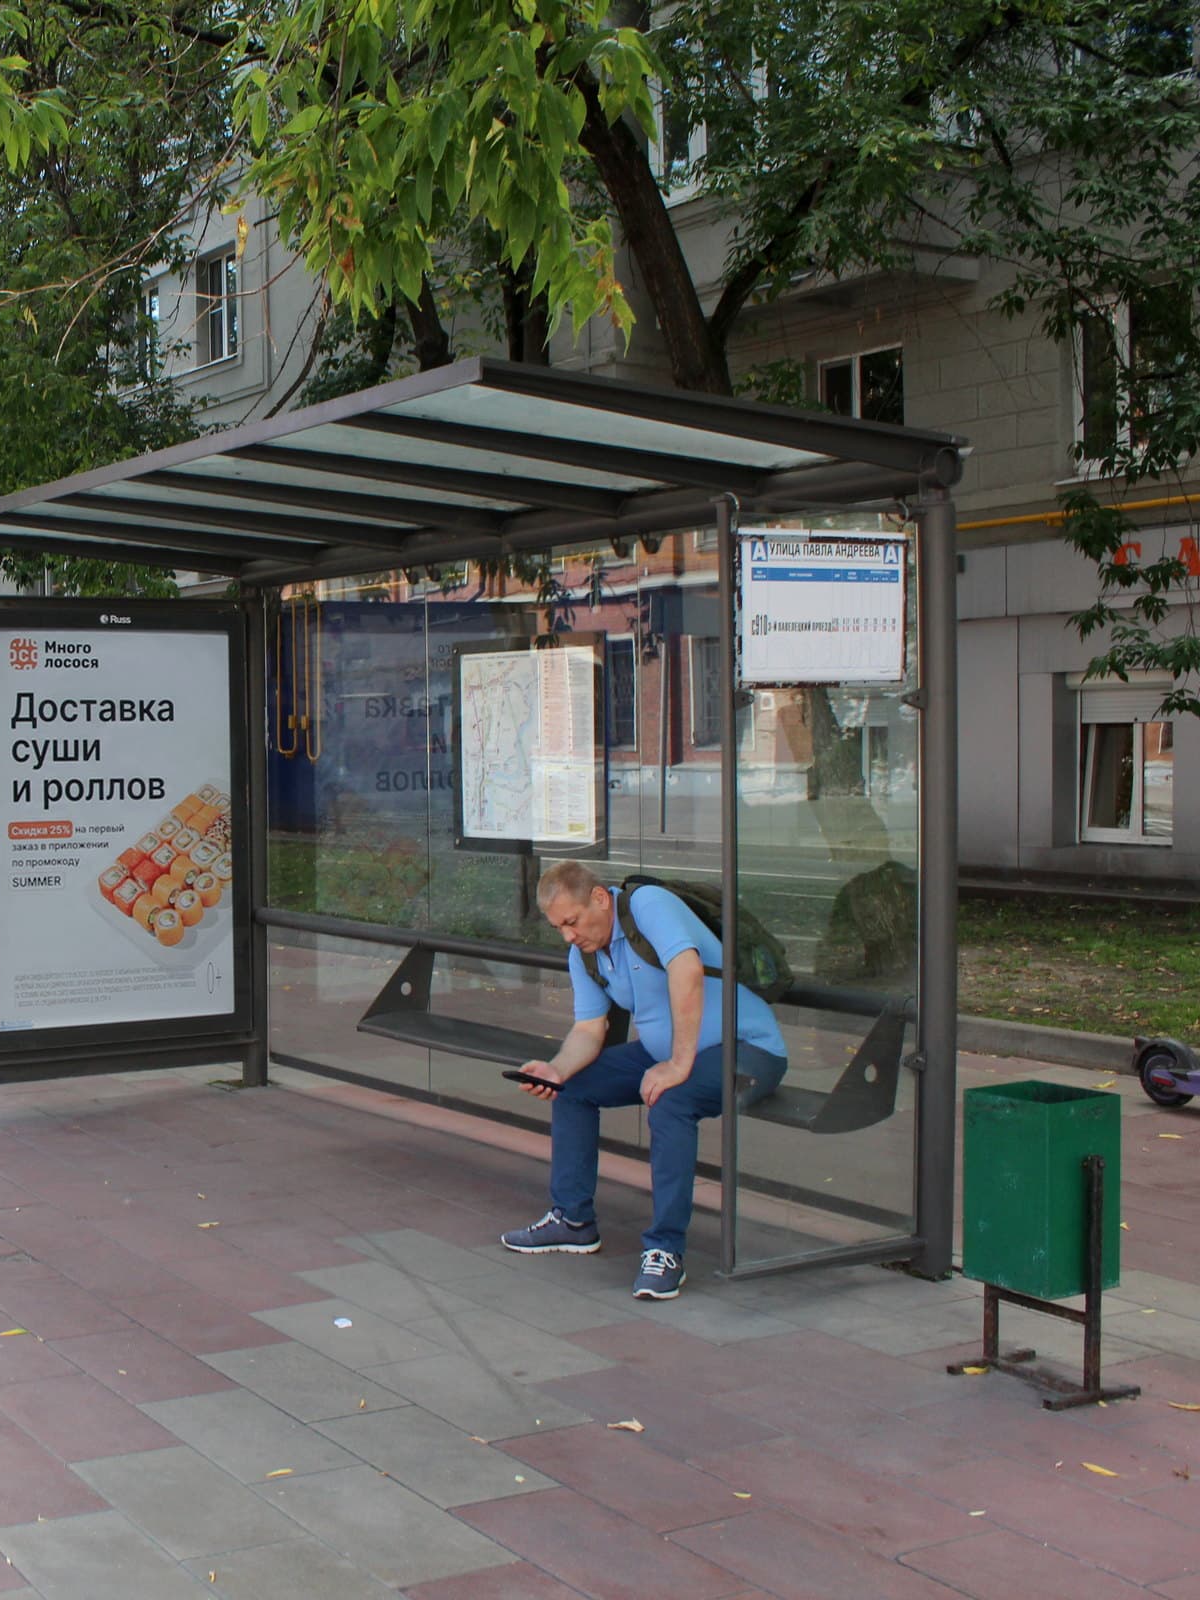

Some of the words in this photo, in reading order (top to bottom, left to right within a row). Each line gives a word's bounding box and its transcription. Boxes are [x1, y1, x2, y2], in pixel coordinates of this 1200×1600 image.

[769, 543, 800, 557] УЛИЦА
[803, 543, 833, 557] ПАВЛА
[835, 544, 880, 559] АНДРЕЕВА
[109, 614, 132, 624] Russ
[44, 640, 92, 654] Много
[44, 658, 99, 669] лосося
[10, 692, 175, 730] Доставка
[11, 737, 101, 769] суши
[13, 779, 32, 803] и
[43, 774, 167, 810] роллов
[11, 825, 48, 837] Скидка
[49, 824, 71, 835] 25%
[75, 825, 87, 833] на
[88, 823, 125, 835] первый
[48, 841, 109, 852] приложении
[12, 859, 24, 867] по
[25, 857, 80, 868] промокоду
[12, 876, 62, 888] SUMMER
